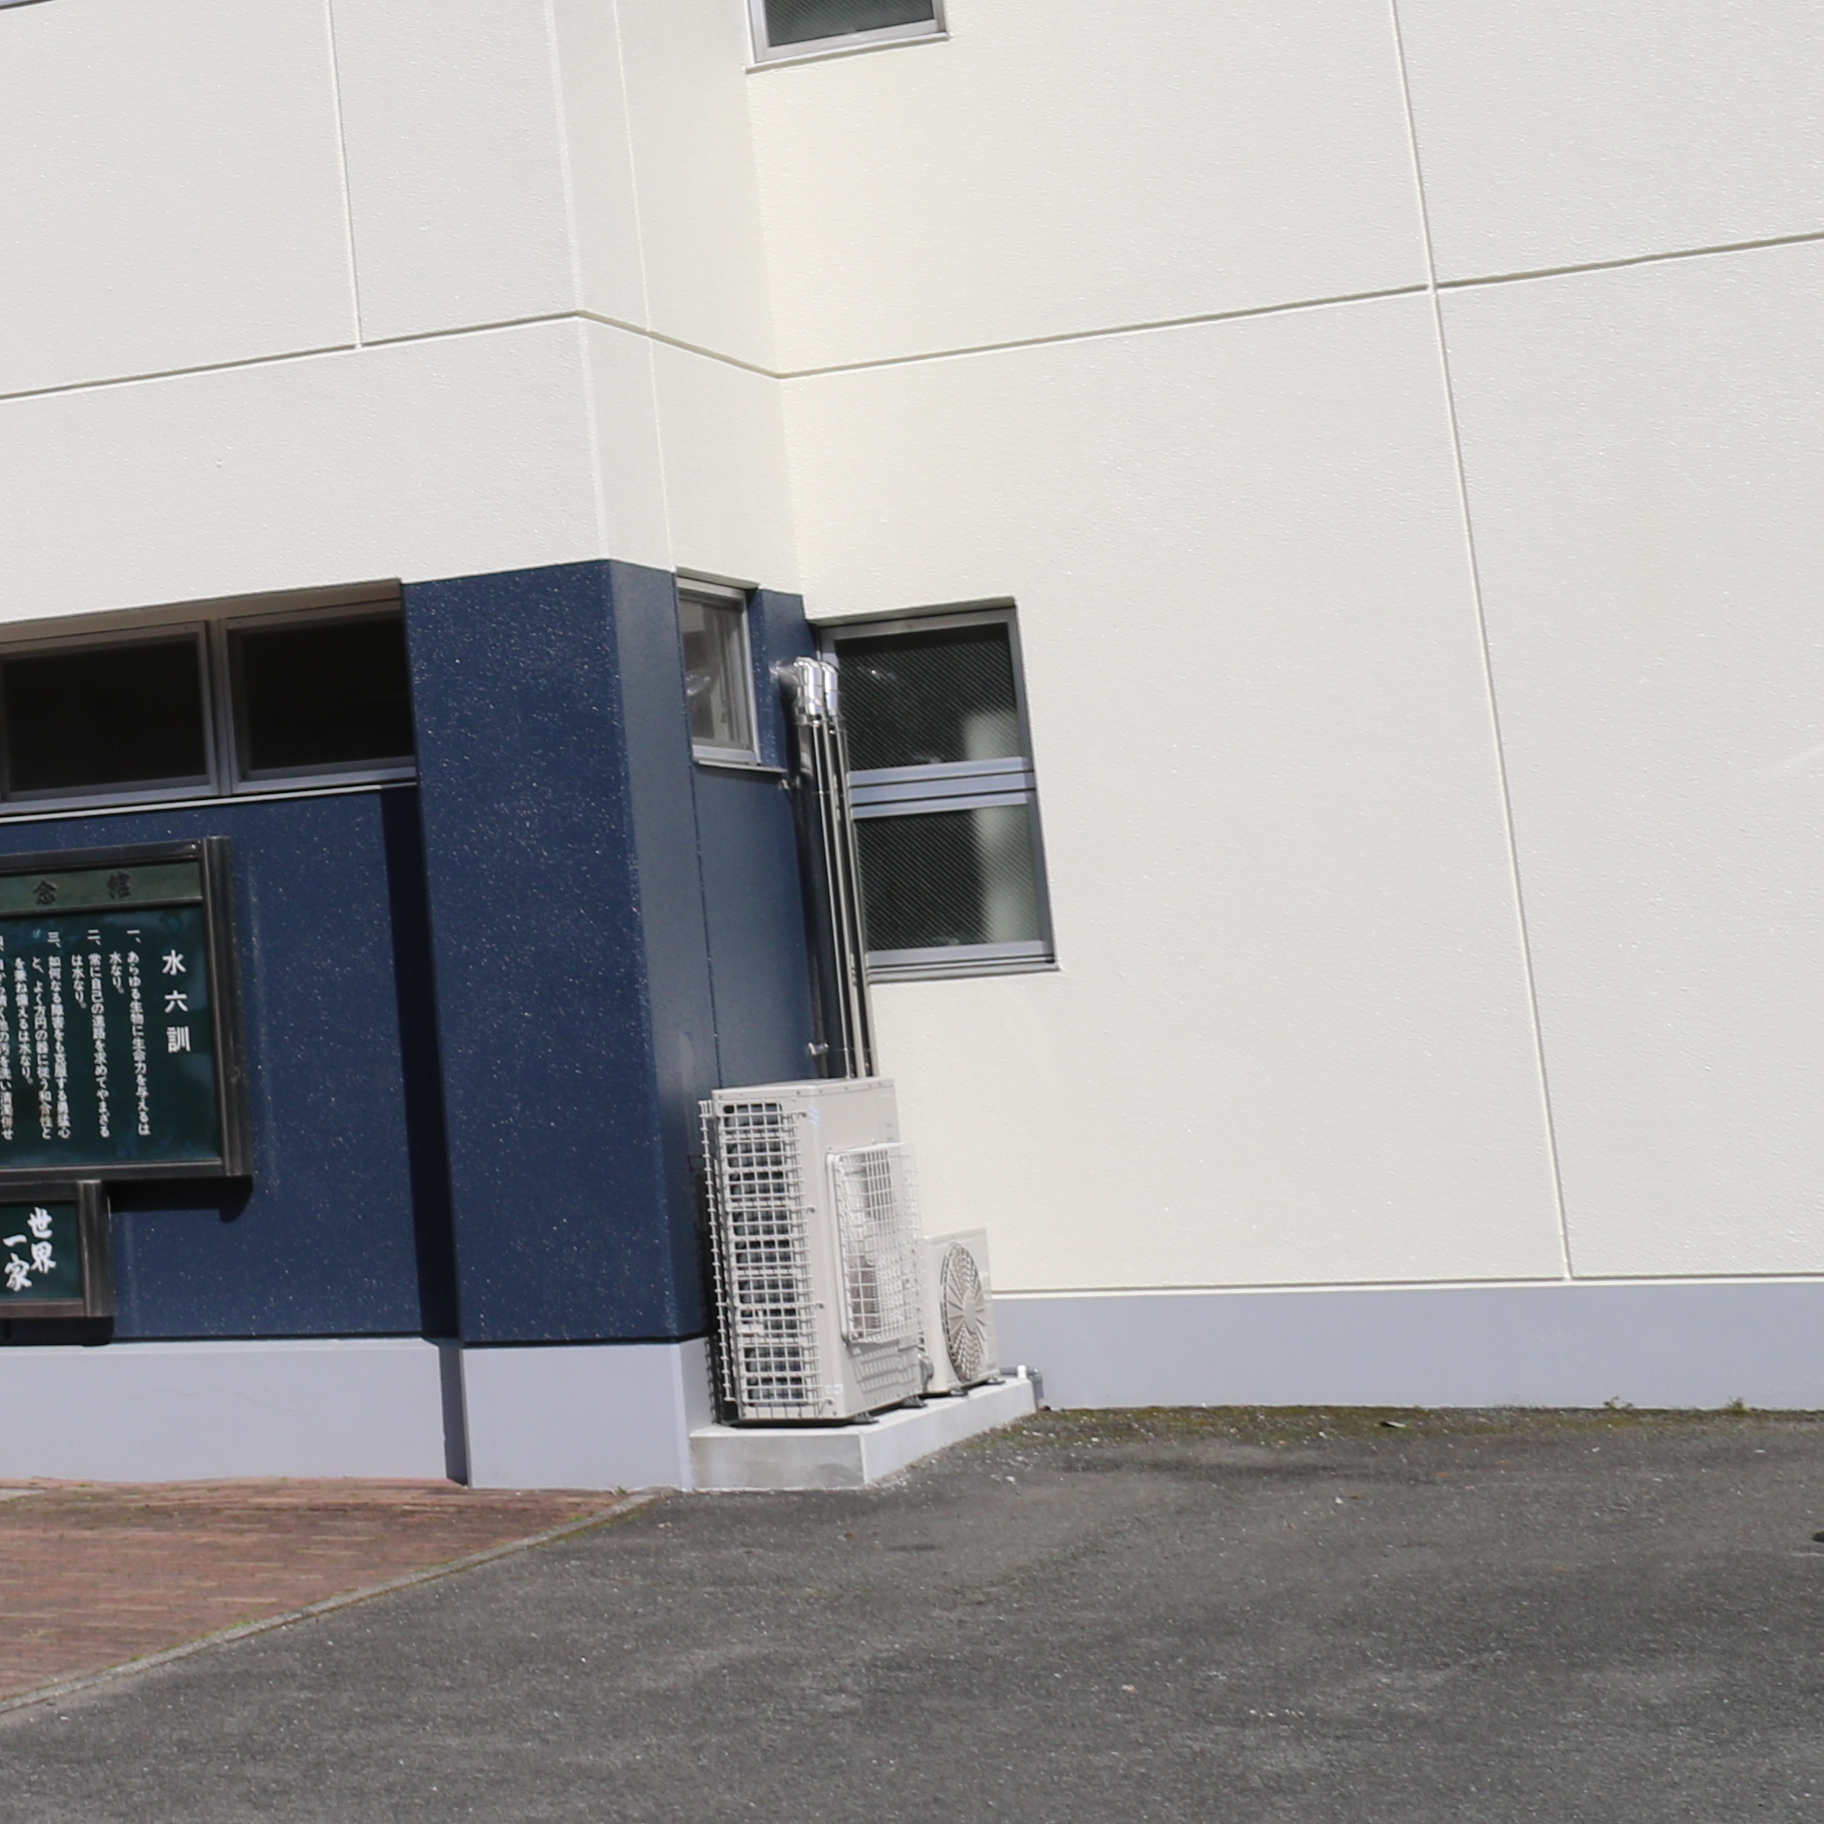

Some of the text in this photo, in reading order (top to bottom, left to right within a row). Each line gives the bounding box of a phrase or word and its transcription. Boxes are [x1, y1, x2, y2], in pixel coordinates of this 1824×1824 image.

[71, 955, 86, 1009] は水なり。
[109, 952, 125, 994] 水なり。
[161, 951, 191, 1052] 水六訓
[3, 1235, 32, 1292] 一家
[27, 1207, 56, 1274] 世界
